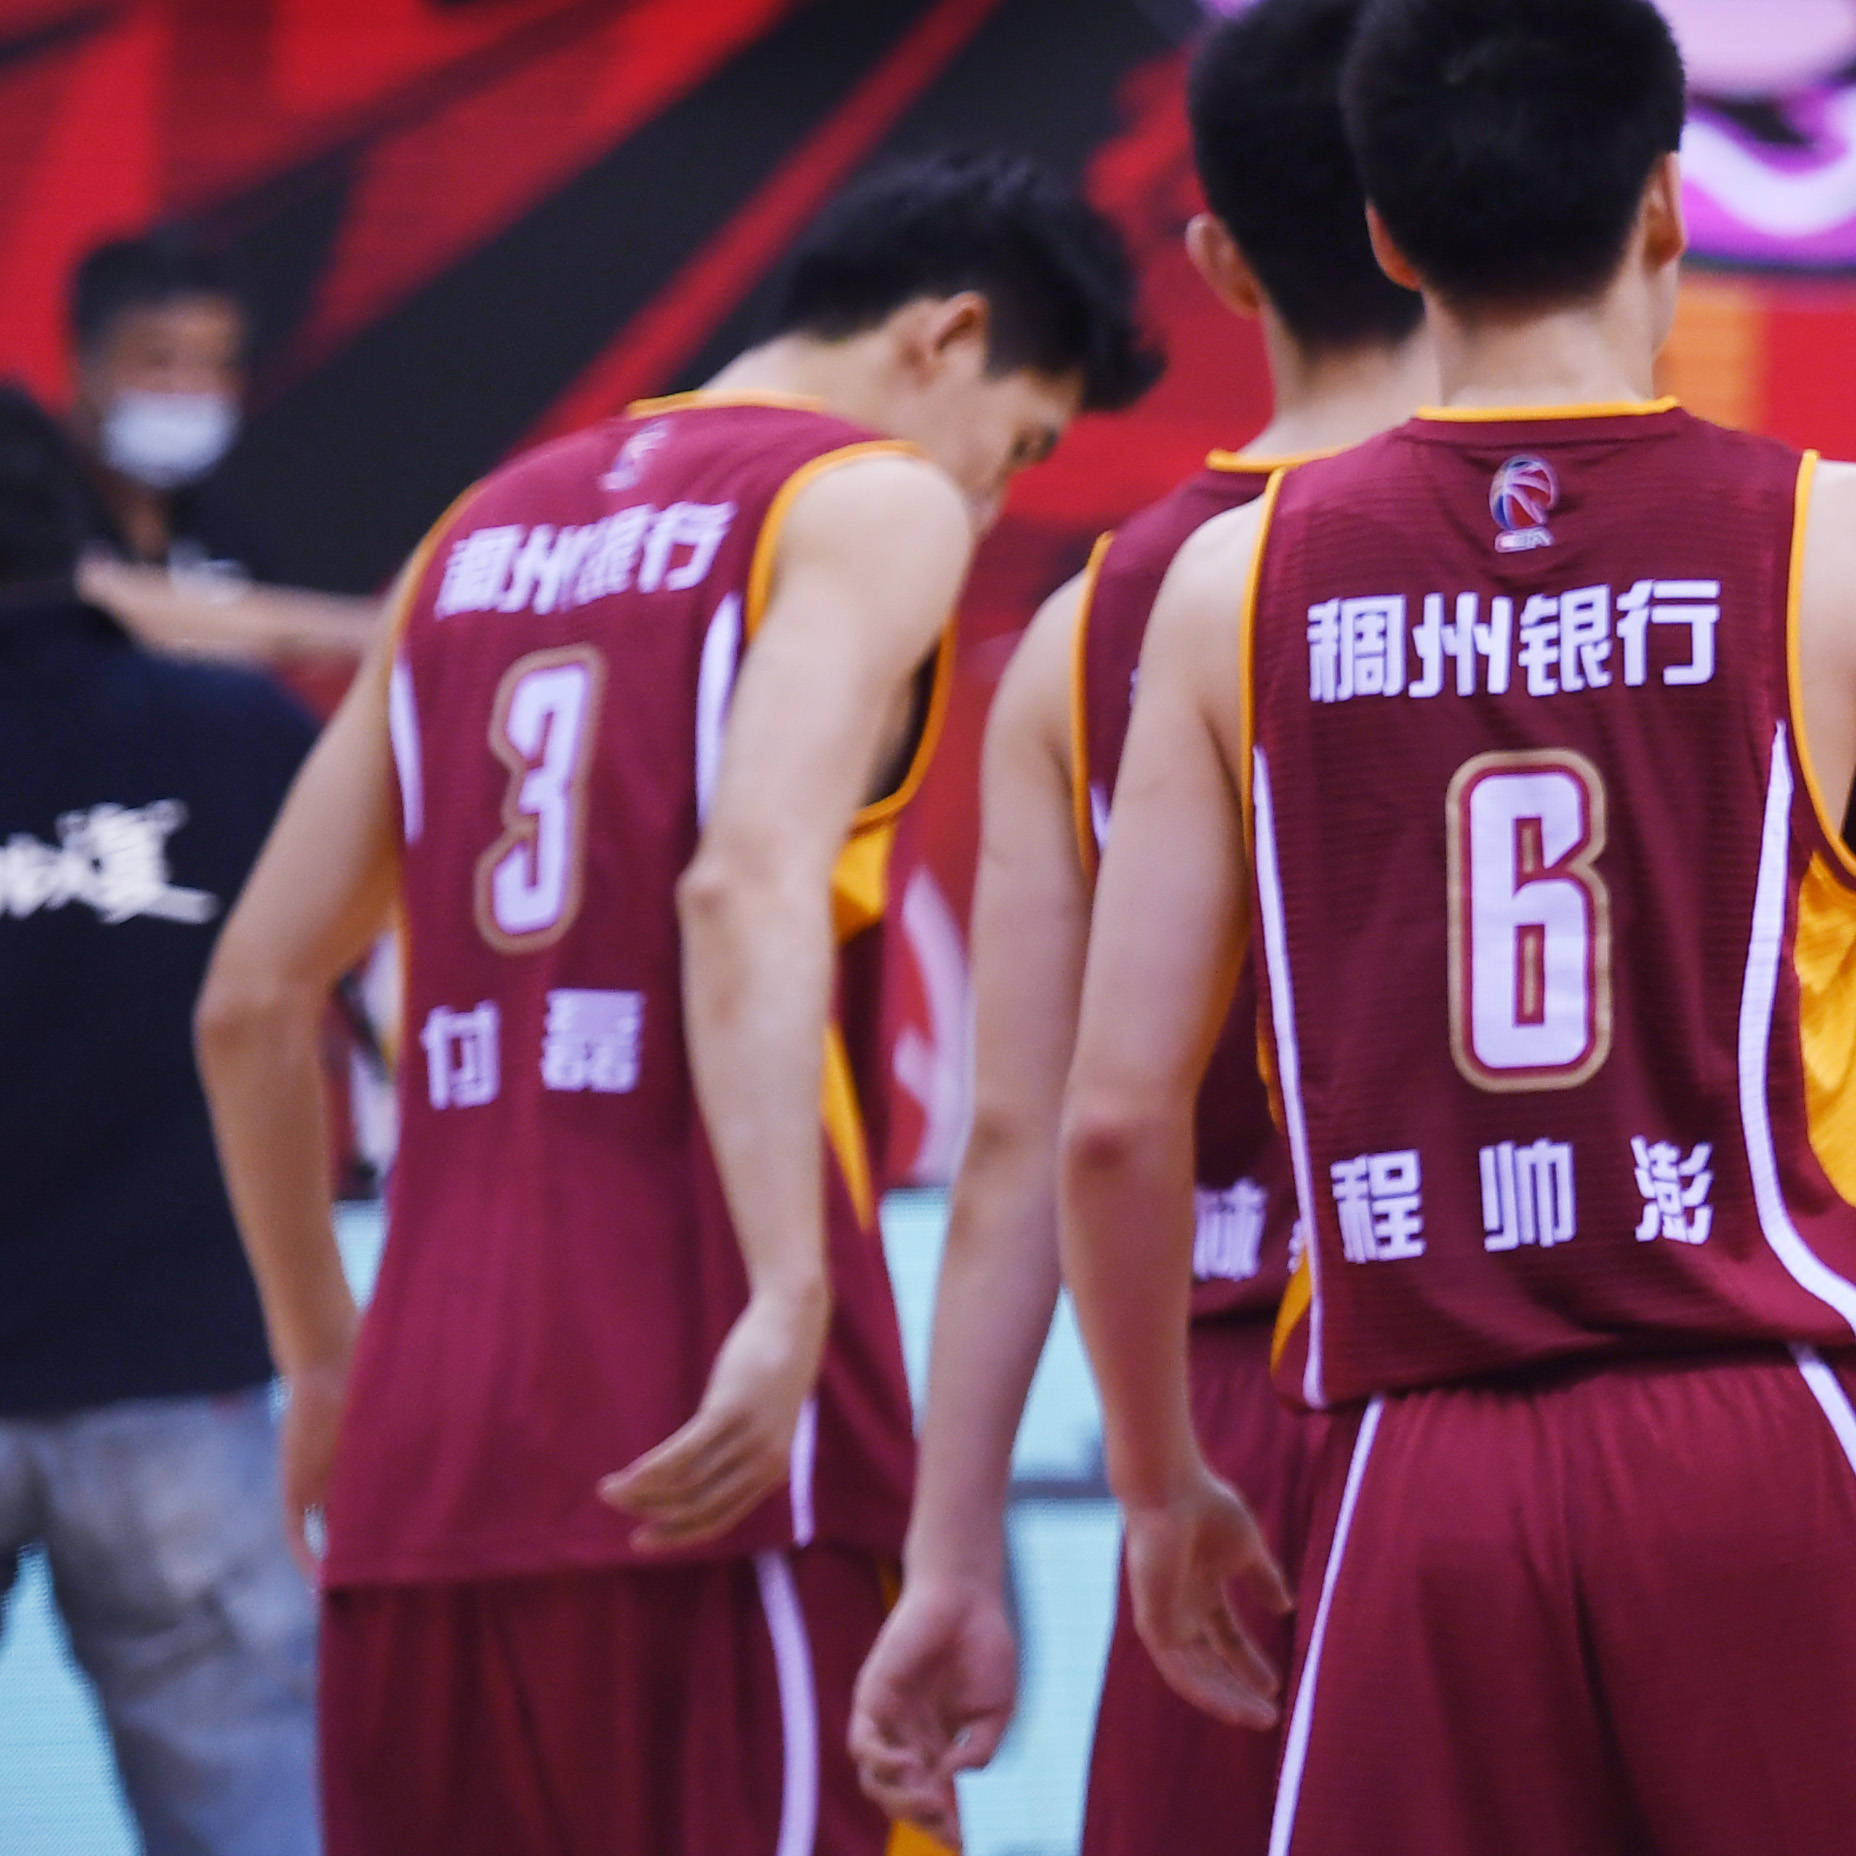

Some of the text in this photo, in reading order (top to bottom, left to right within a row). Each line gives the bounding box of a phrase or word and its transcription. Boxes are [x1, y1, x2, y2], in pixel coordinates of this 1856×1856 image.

[1305, 578, 1721, 704] 稠州银行
[478, 647, 604, 950] 3
[1449, 751, 1609, 1088] 6
[1331, 1138, 1714, 1263] 程帅澎
